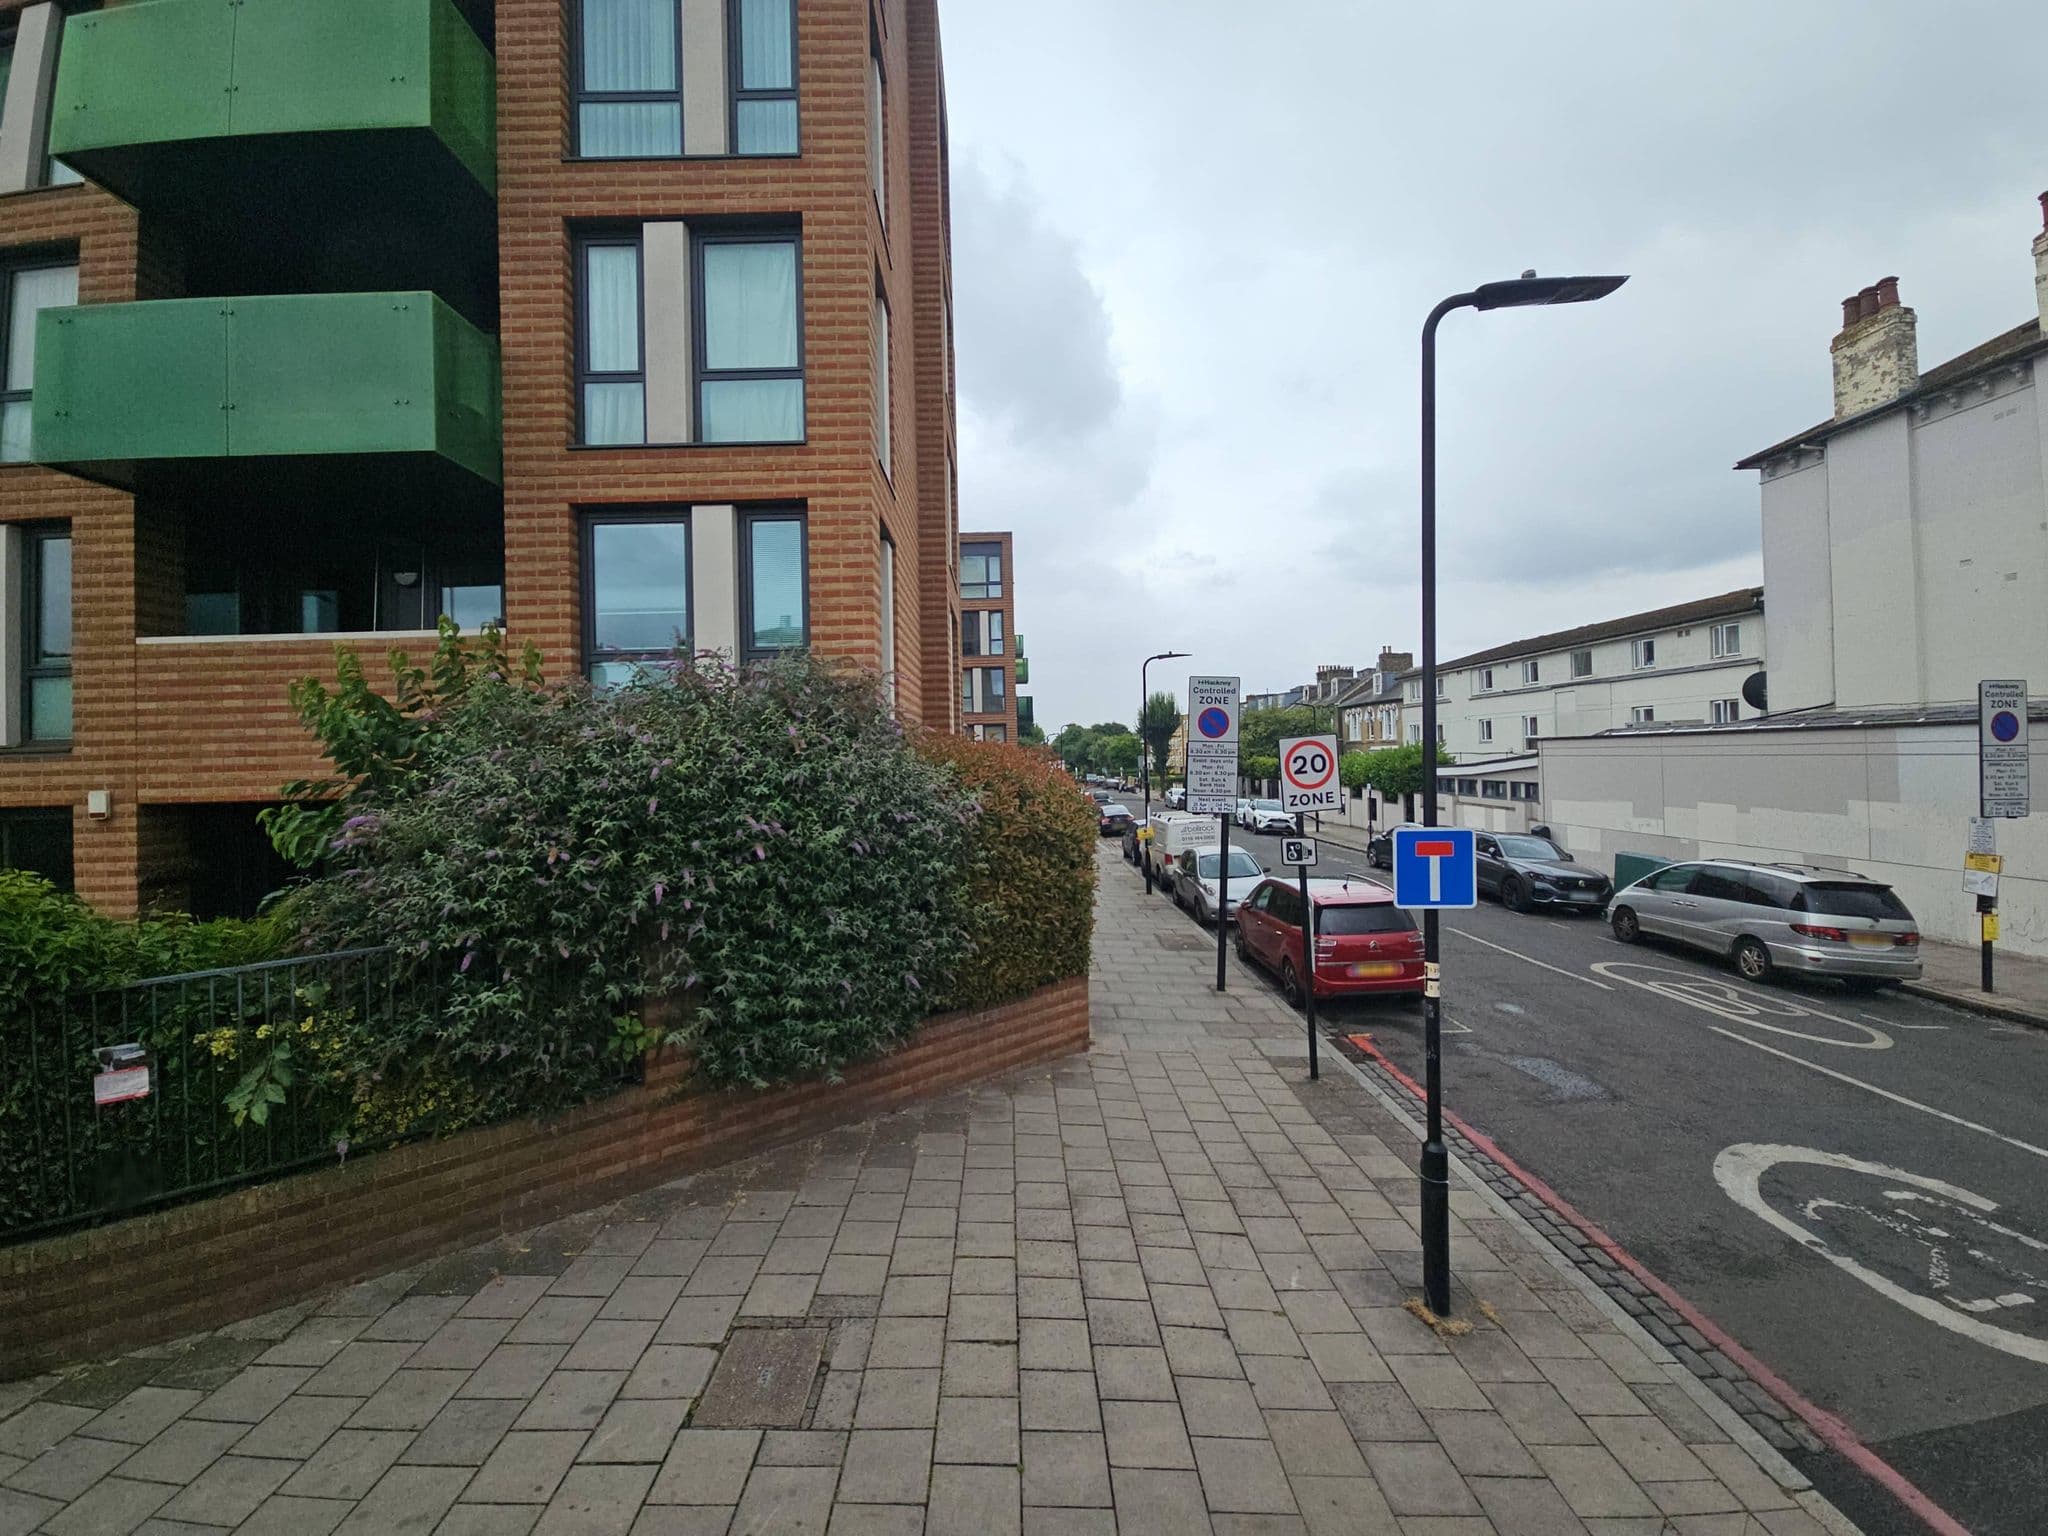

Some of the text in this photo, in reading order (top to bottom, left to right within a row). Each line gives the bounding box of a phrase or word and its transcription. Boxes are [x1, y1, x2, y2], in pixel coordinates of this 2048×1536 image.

[1199, 696, 1229, 705] ZONE
[1991, 699, 2018, 708] ZONE
[1292, 753, 1327, 775] 20
[1289, 791, 1335, 807] ZONE
